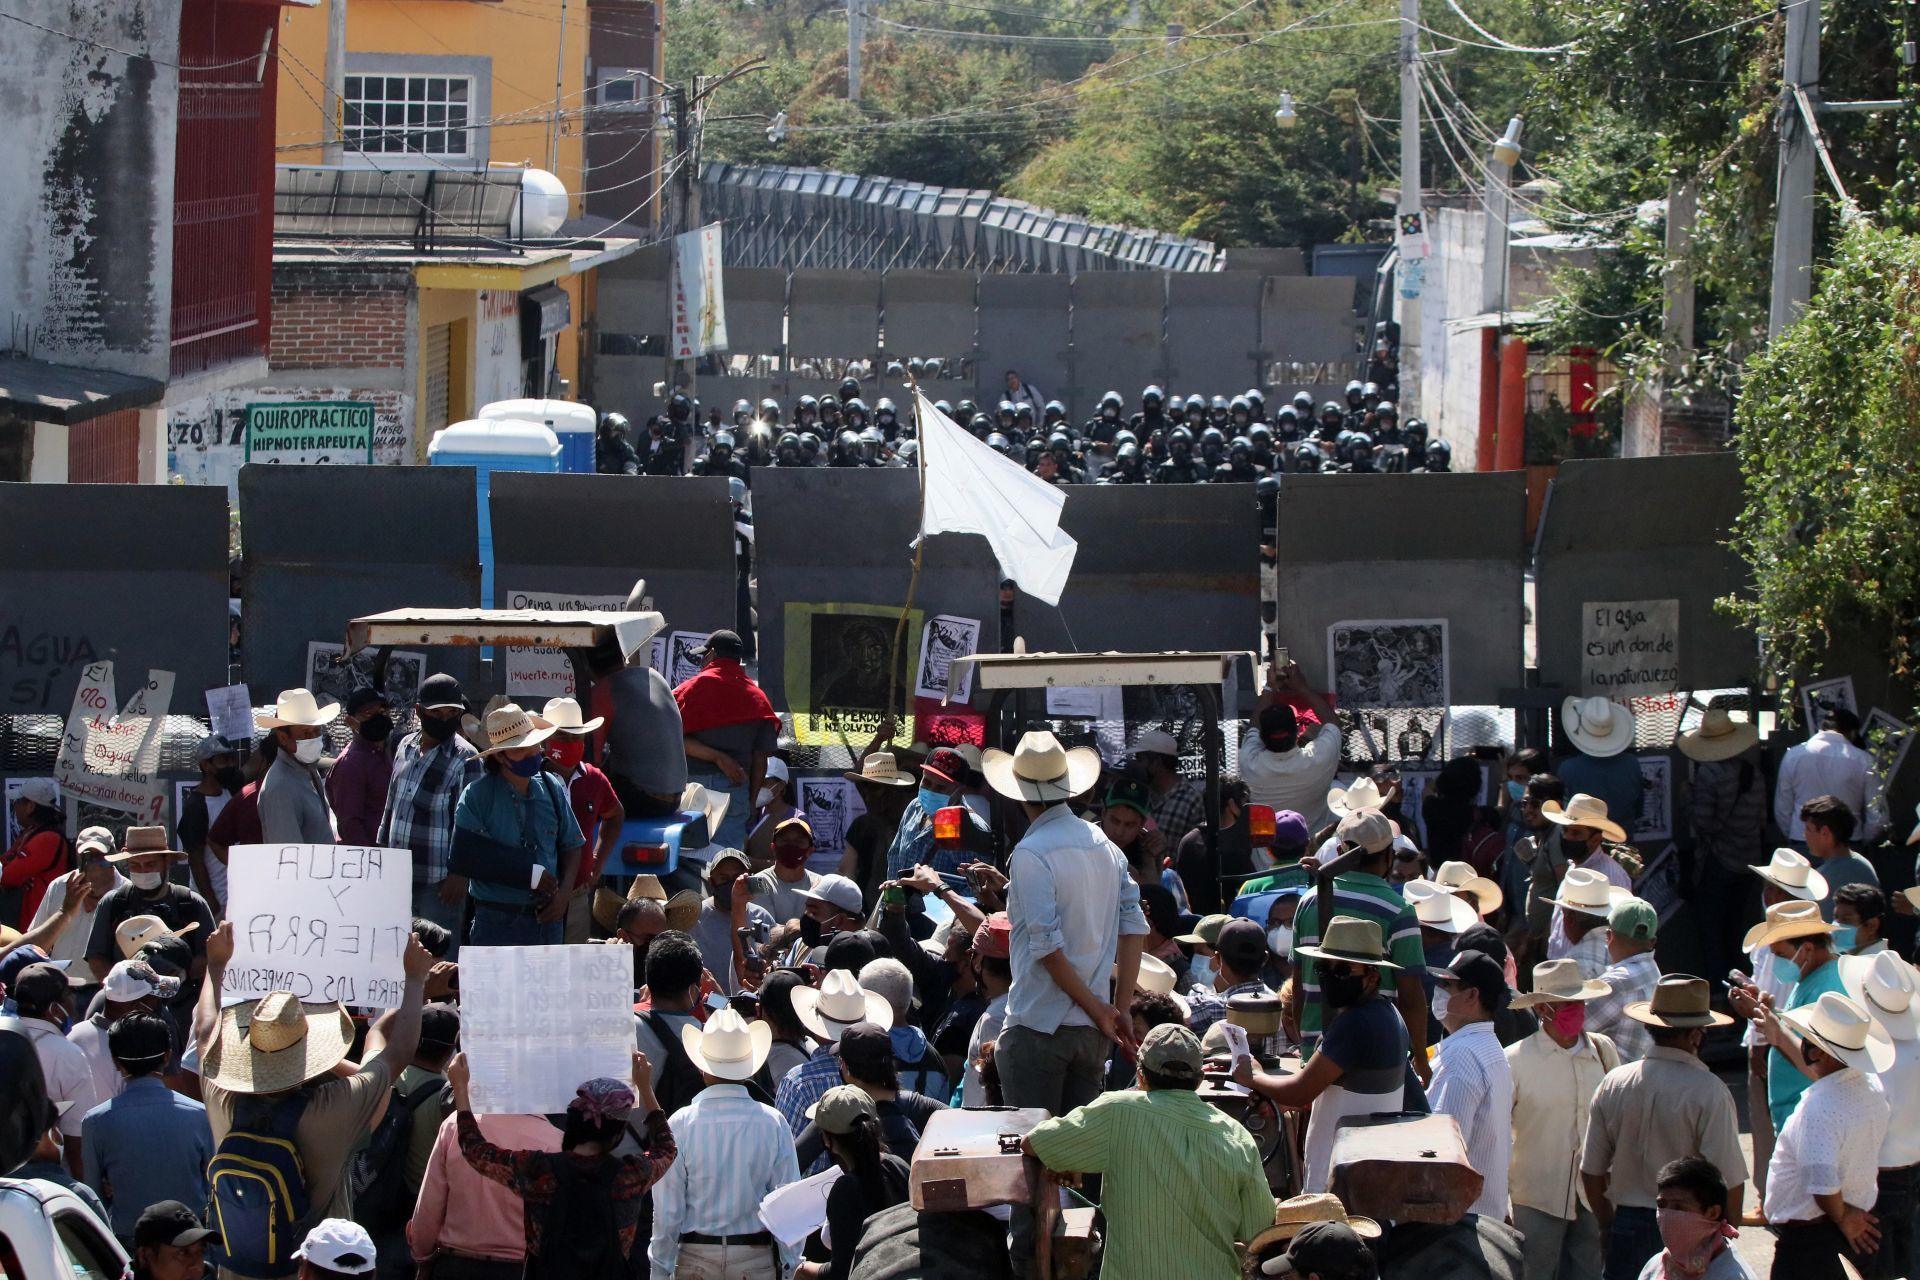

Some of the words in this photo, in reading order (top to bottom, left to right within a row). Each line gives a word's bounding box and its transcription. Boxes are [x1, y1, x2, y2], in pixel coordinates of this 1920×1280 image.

[253, 409, 368, 432] QUIROPRACTICO
[253, 434, 367, 451] HIPNOTERAPEUTA
[0, 625, 98, 668] AGUA
[824, 723, 840, 732] NI
[842, 722, 879, 734] OLVID
[121, 766, 148, 785] bella
